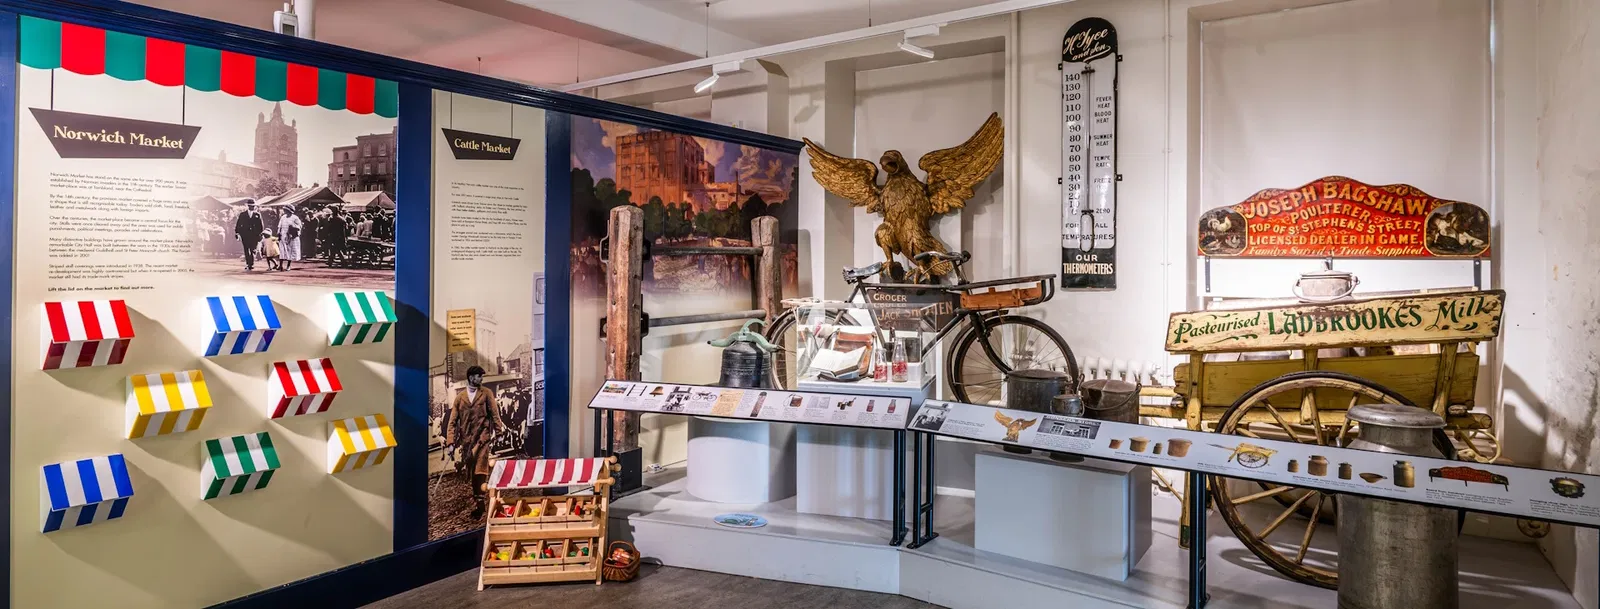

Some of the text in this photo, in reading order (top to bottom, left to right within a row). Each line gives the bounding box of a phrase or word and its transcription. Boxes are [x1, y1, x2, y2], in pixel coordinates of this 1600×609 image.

[1065, 74, 1080, 82] 140
[1065, 83, 1080, 91] 130
[1065, 93, 1081, 101] 120
[1066, 104, 1081, 112] 110
[1066, 114, 1081, 122] 100
[1069, 124, 1081, 133] 90
[54, 125, 184, 149] Norwich Market
[1069, 134, 1081, 142] 80
[454, 138, 511, 154] Cattle Market
[1245, 186, 1318, 219] JOSEPH
[1290, 203, 1372, 224] POULTERER,
[1250, 223, 1270, 233] TOP
[1273, 224, 1286, 233] OF
[1302, 218, 1364, 233] STEPHEN'S
[1367, 220, 1421, 234] STREET,
[1250, 234, 1423, 245] LICENSED DEALER IN GAME,
[1248, 246, 1287, 256] Familys
[1339, 246, 1370, 255] Trade
[1373, 246, 1425, 256] Supplied.
[1063, 263, 1113, 275] THERMOMETERS
[873, 293, 907, 302] GROCER
[878, 309, 900, 320] JACK
[1174, 312, 1260, 344] Pasteurised
[1424, 297, 1490, 331] Milk
